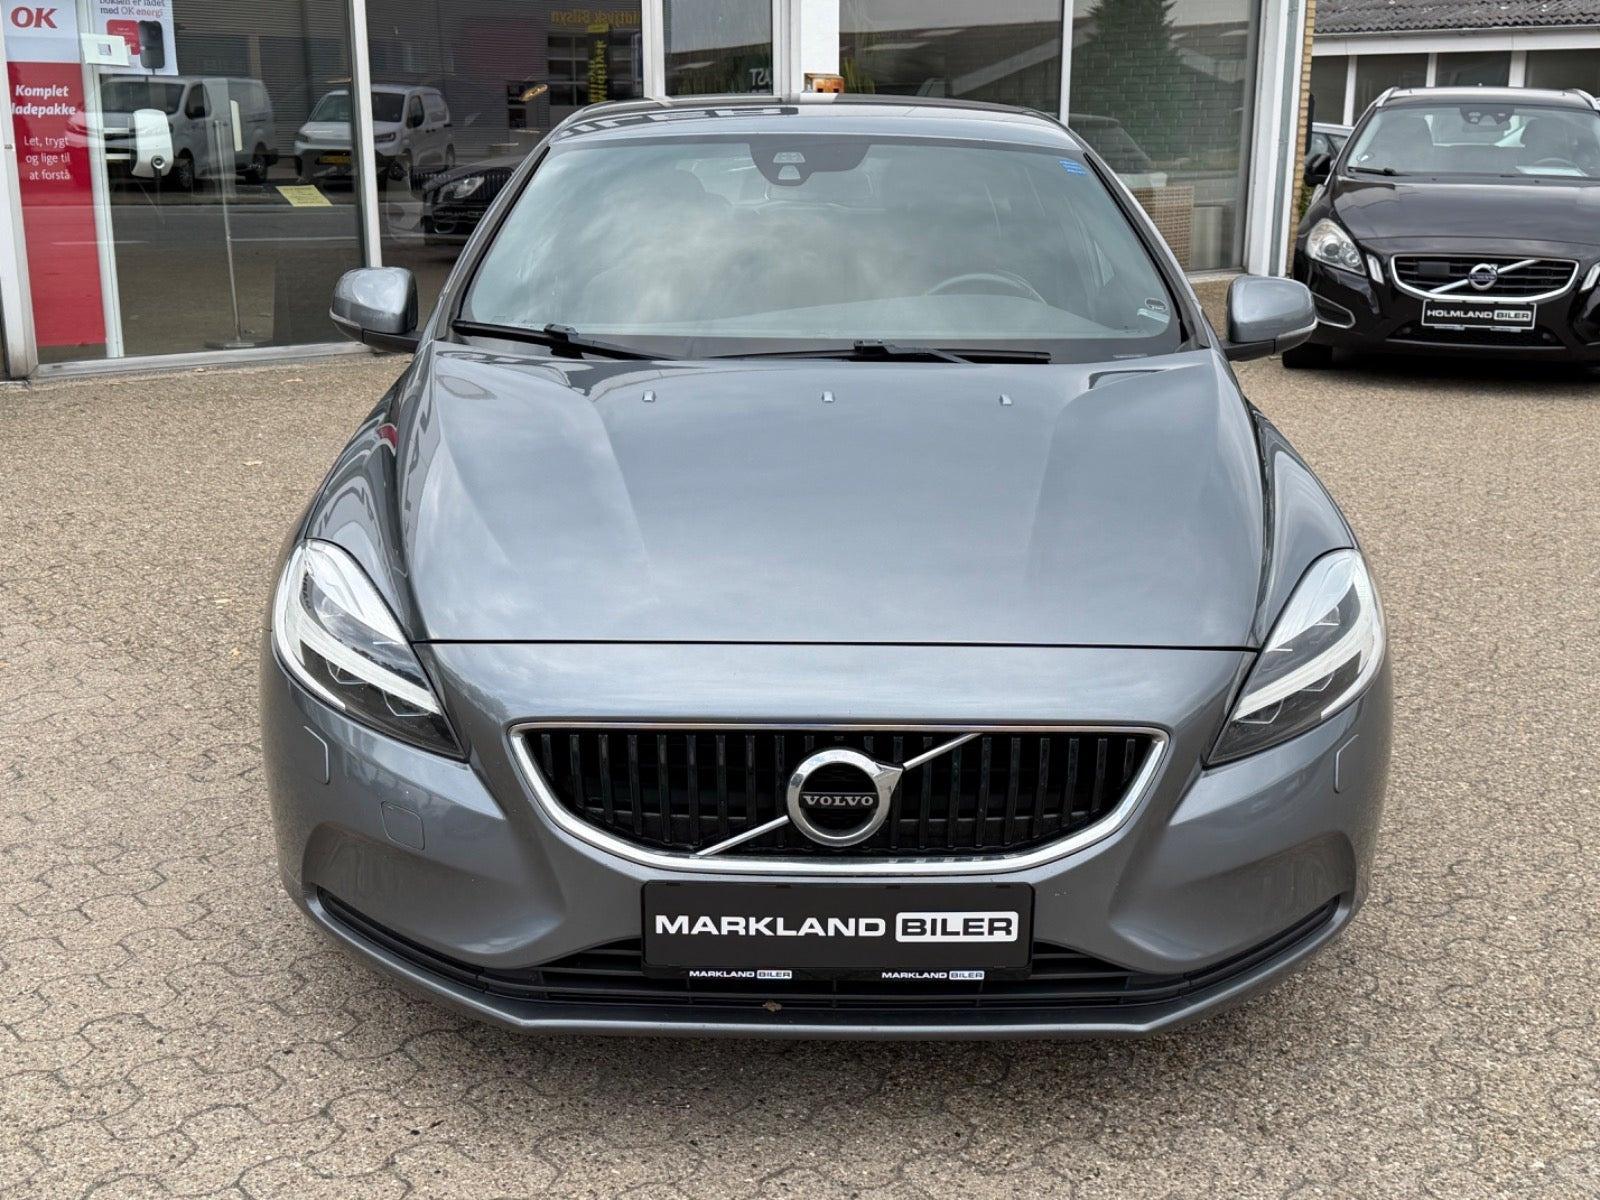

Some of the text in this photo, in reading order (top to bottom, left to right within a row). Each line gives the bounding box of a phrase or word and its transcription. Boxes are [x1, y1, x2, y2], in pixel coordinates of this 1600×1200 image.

[11, 7, 58, 29] OK
[100, 7, 163, 18] med OK energi
[15, 84, 69, 100] Komplet
[12, 103, 76, 118] ladepakke
[24, 136, 69, 149] Let, trygt
[26, 152, 71, 166] og lige til
[29, 169, 71, 180] at forstå
[1426, 309, 1530, 320] HOLMLAND BILER
[803, 795, 874, 806] VOLVO
[655, 914, 1013, 937] MARKLAND BILER
[689, 970, 791, 979] MARKLAND BILER
[950, 971, 984, 979] BILER
